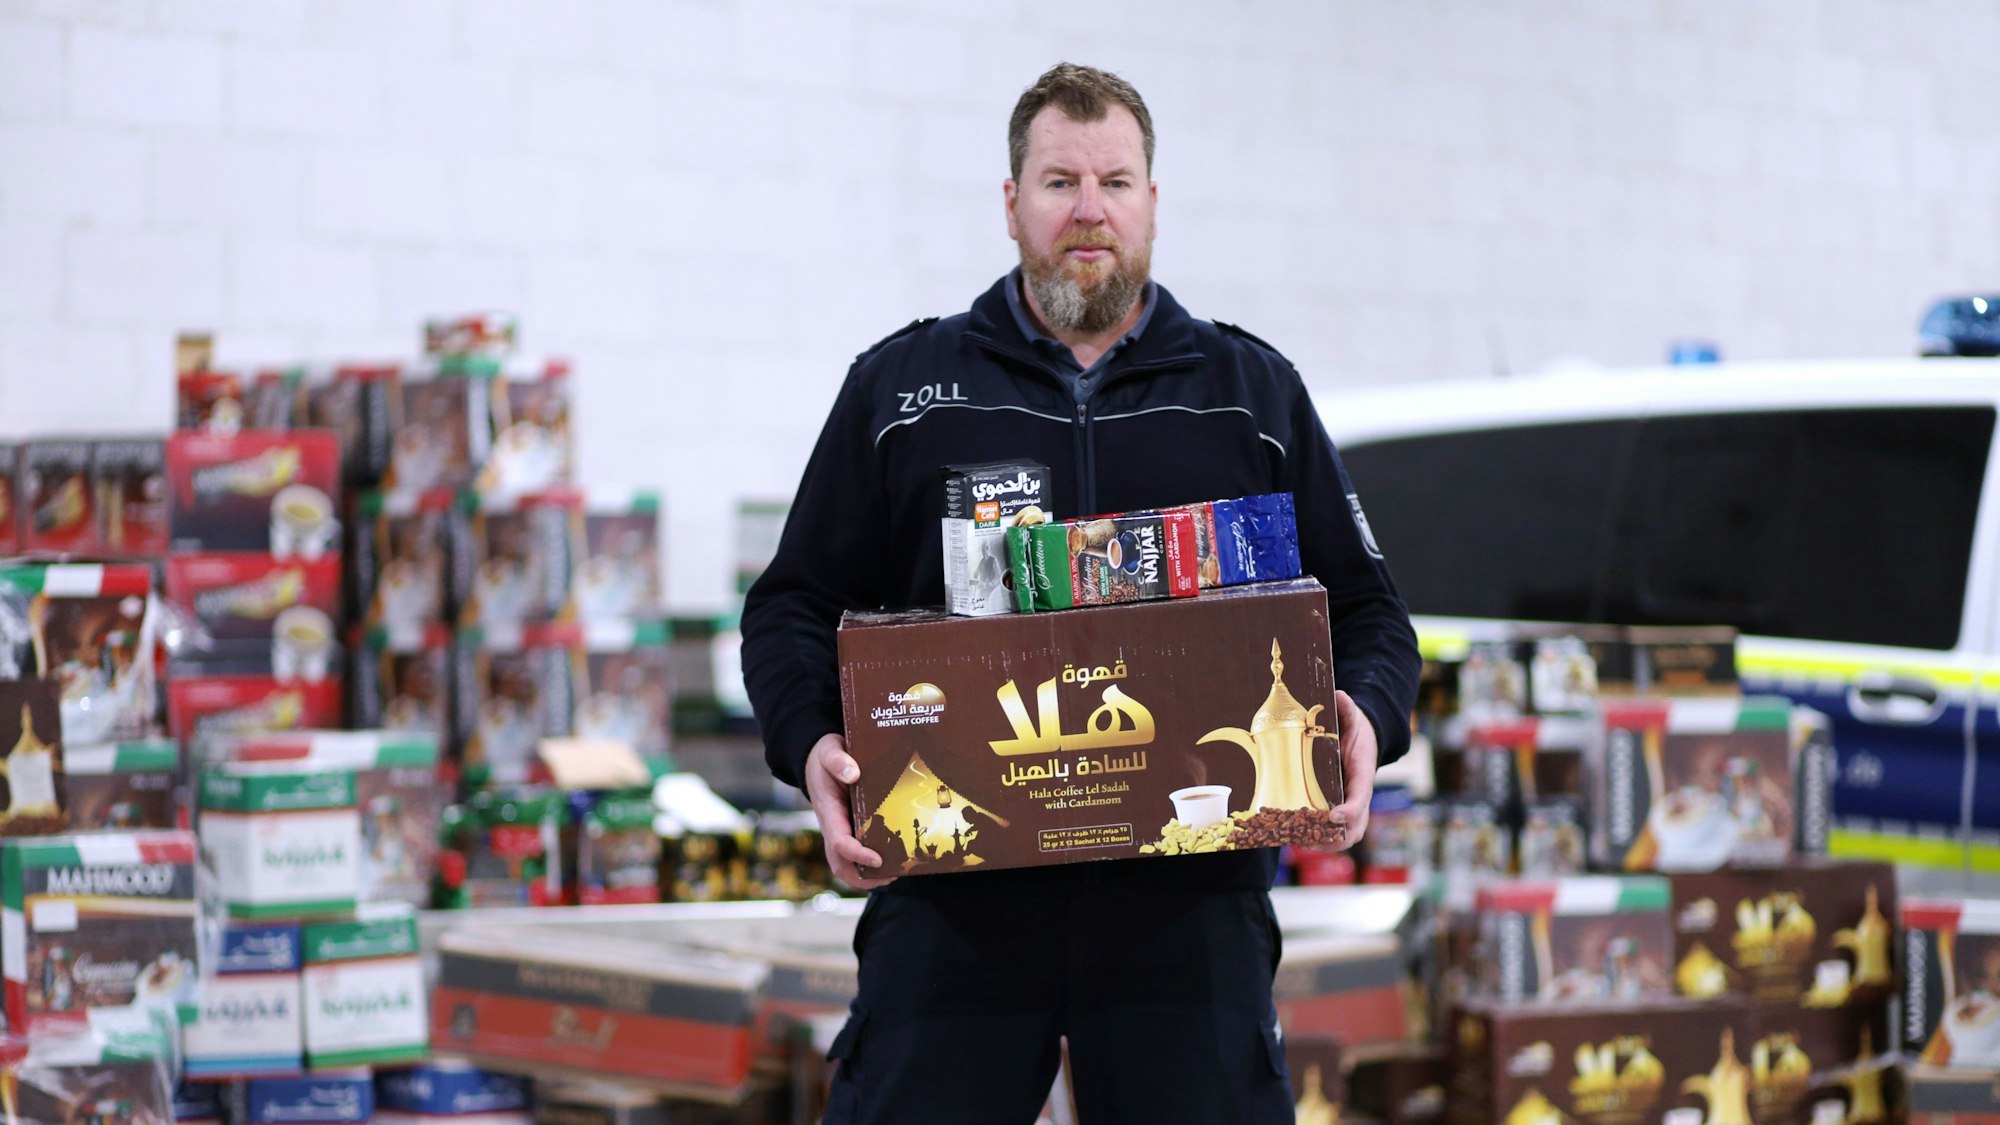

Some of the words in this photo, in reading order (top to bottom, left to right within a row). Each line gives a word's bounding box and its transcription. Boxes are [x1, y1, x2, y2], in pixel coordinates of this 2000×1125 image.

[897, 382, 968, 412] ZOLL
[1141, 524, 1159, 584] NAJJAR
[1231, 522, 1245, 570] Selection
[1034, 539, 1053, 590] Selection
[1081, 556, 1098, 600] Selection
[1071, 574, 1080, 600] ARABICA
[1062, 659, 1128, 689] قهوة
[888, 691, 921, 704] قهوة
[909, 704, 945, 716] سريعة
[870, 704, 906, 720] الذوبان
[877, 718, 910, 728] INSTANT
[910, 715, 940, 725] COFFEE
[988, 676, 1156, 757] هلا
[1001, 758, 1070, 787] بالهيل
[1076, 751, 1147, 776] للسادة
[1029, 788, 1052, 799] Hala
[1053, 784, 1084, 797] Coffee
[1085, 783, 1100, 795] Lel
[1101, 781, 1130, 793] Sadah
[1045, 799, 1067, 810] with
[1068, 796, 1122, 808] Cardamom
[1073, 838, 1095, 846] Sachet
[47, 862, 174, 896] MAHMOOD
